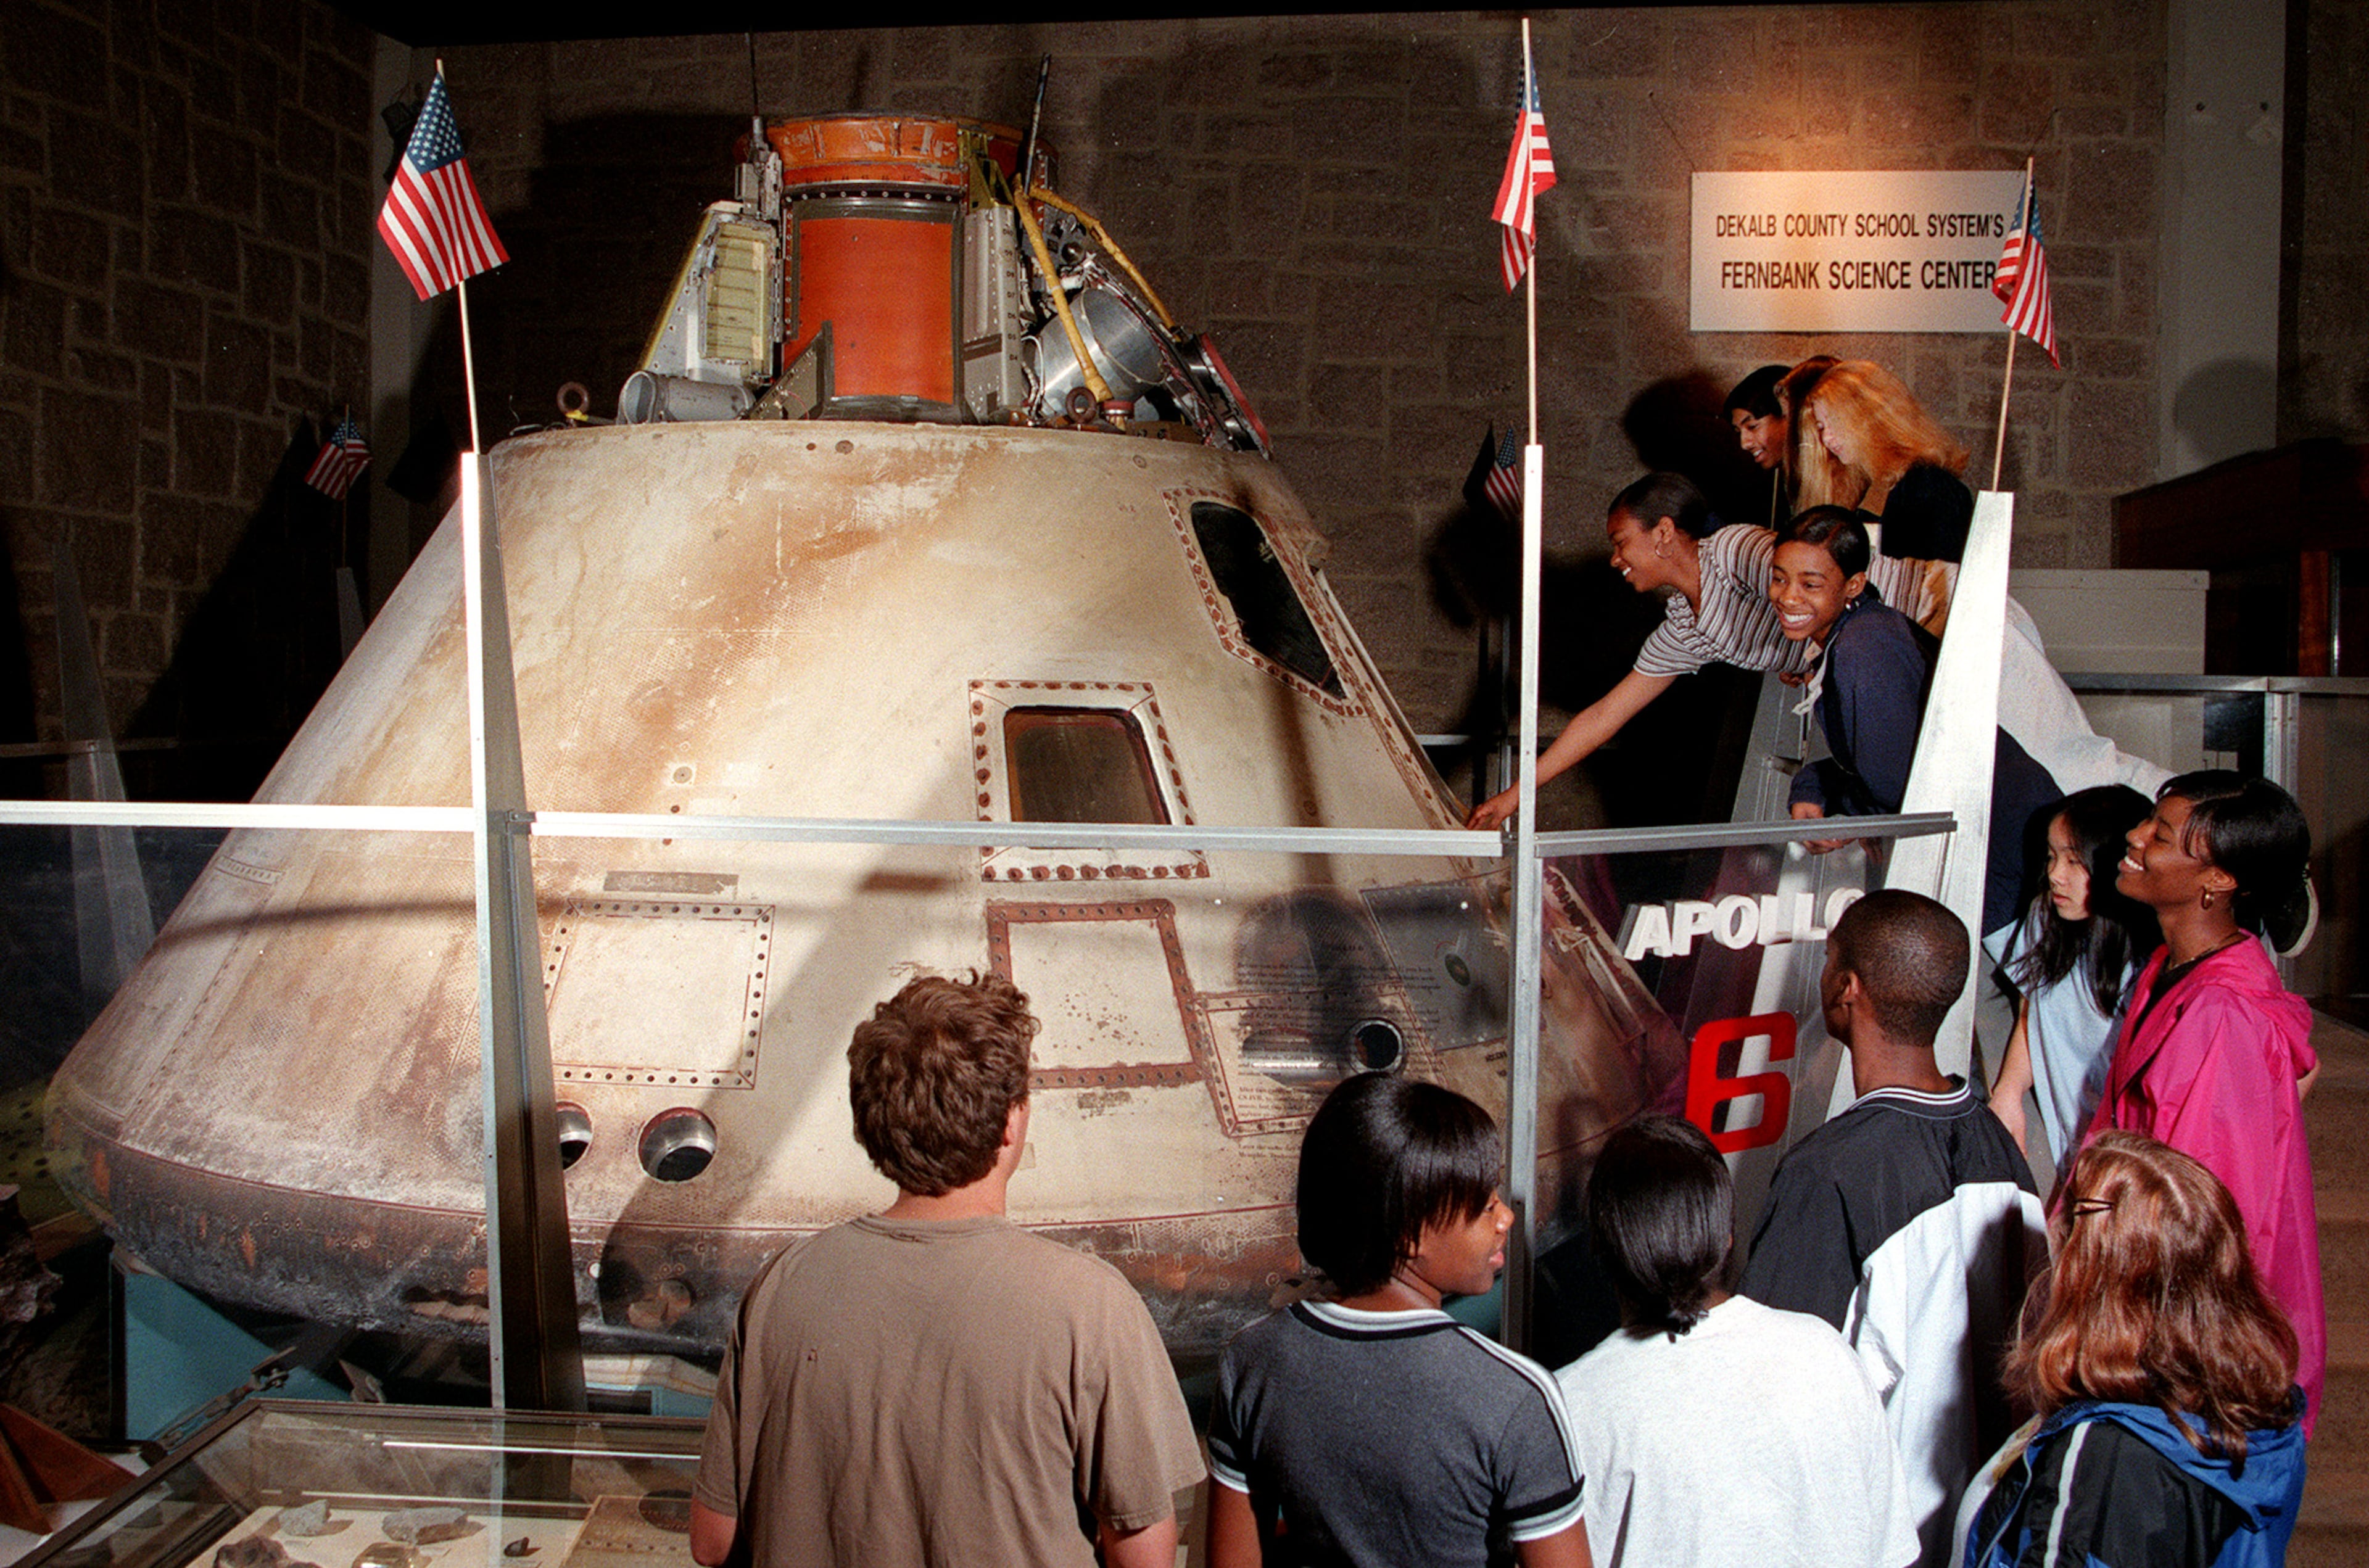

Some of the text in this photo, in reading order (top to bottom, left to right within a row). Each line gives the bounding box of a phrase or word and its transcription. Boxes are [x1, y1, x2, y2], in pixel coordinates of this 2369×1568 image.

[1716, 213, 2004, 237] DEKALB COUNTY SCHOOL SYSTEM'S
[1721, 261, 1996, 289] FERNBANK SCIENCE CENTER
[1685, 1011, 1798, 1154] 6
